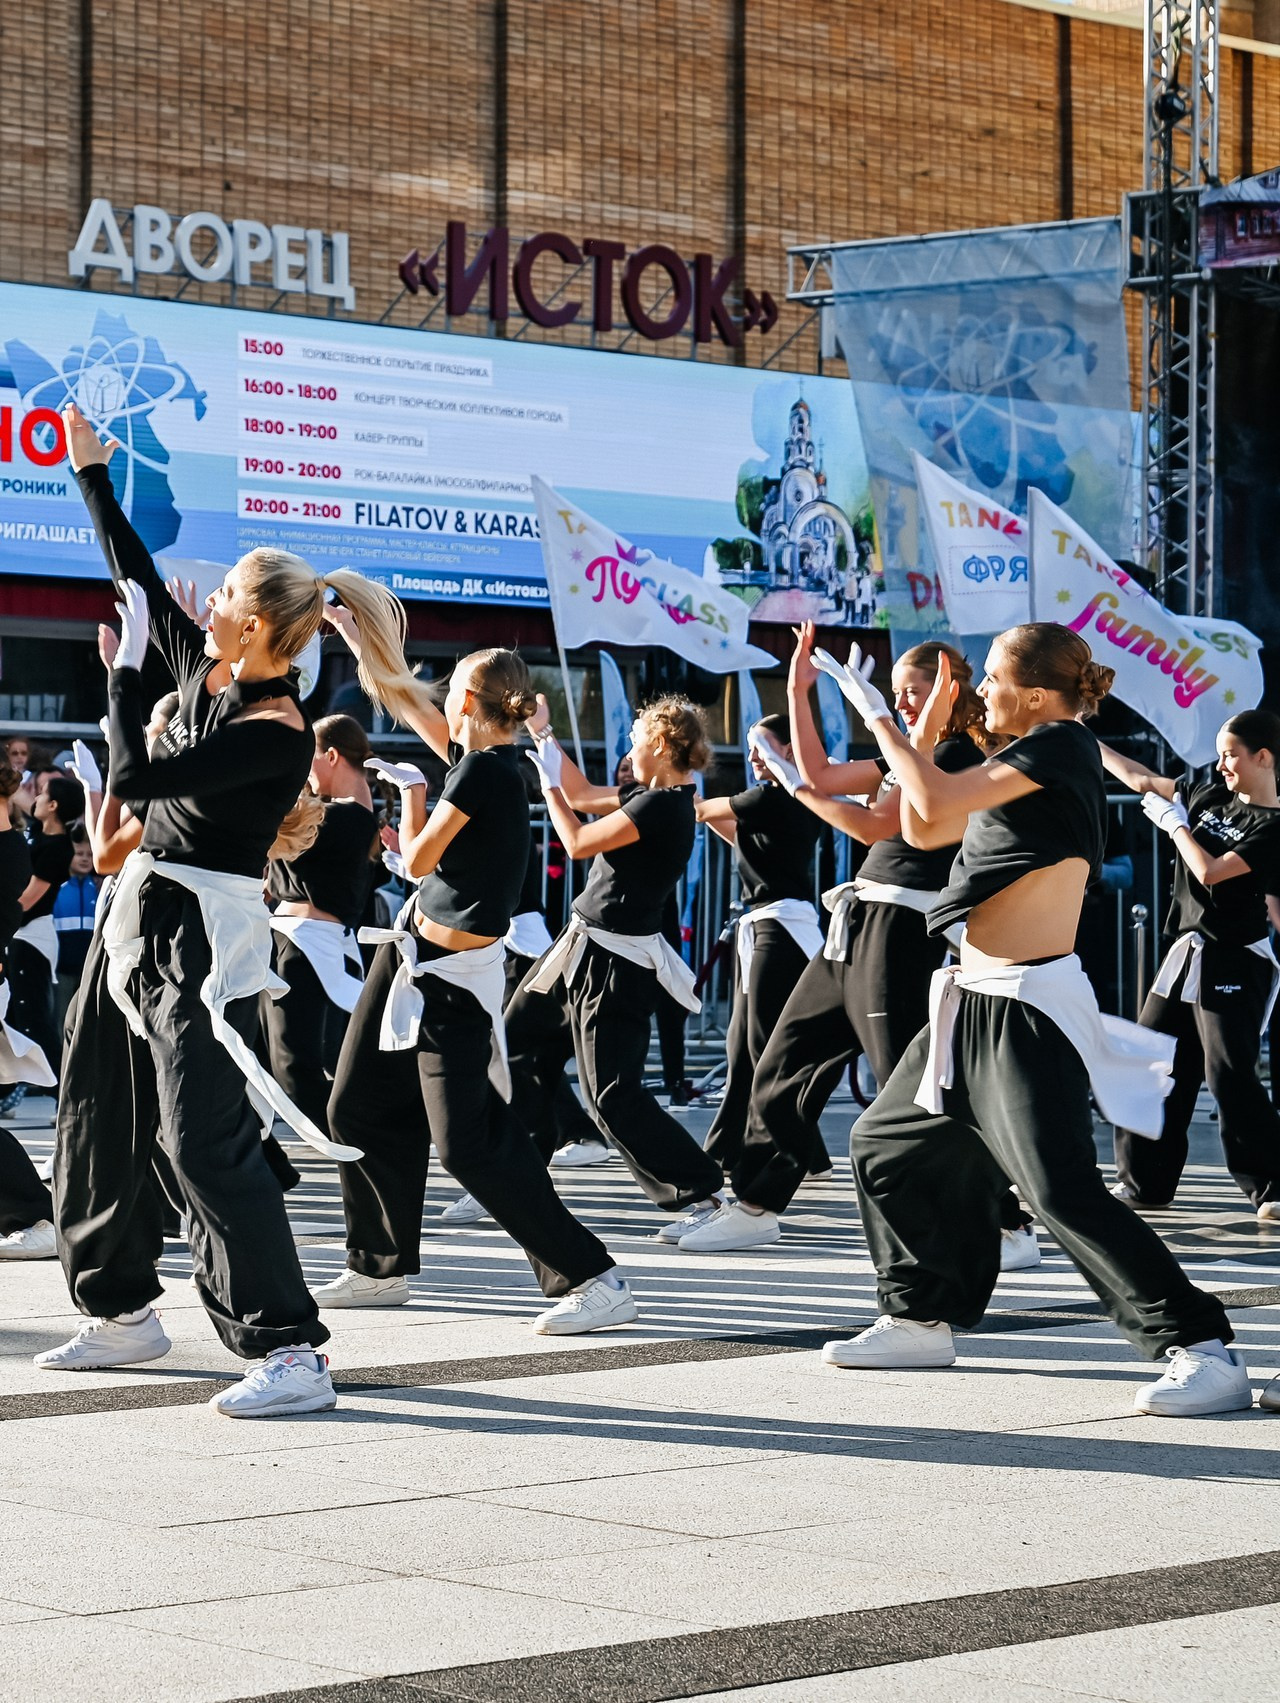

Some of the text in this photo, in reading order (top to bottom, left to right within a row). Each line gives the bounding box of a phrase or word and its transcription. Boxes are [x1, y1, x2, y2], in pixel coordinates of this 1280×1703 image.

[68, 198, 778, 347] ДВОРЕЦ «ИСТОК»
[243, 338, 284, 356] 15:00
[243, 377, 284, 396] 16:00
[297, 383, 338, 401] 18:00
[243, 417, 285, 435] 18:00
[297, 422, 338, 440] 19:00
[243, 457, 285, 475] 19:00
[297, 462, 342, 480] 20:00
[244, 497, 289, 515] 20:00
[302, 501, 342, 519] 21:00
[355, 502, 448, 531] FILATOV
[454, 510, 468, 533] &
[392, 573, 461, 594] Площадь
[462, 578, 483, 596] ДК
[485, 581, 549, 599] «Исток»
[1065, 592, 1219, 709] family
